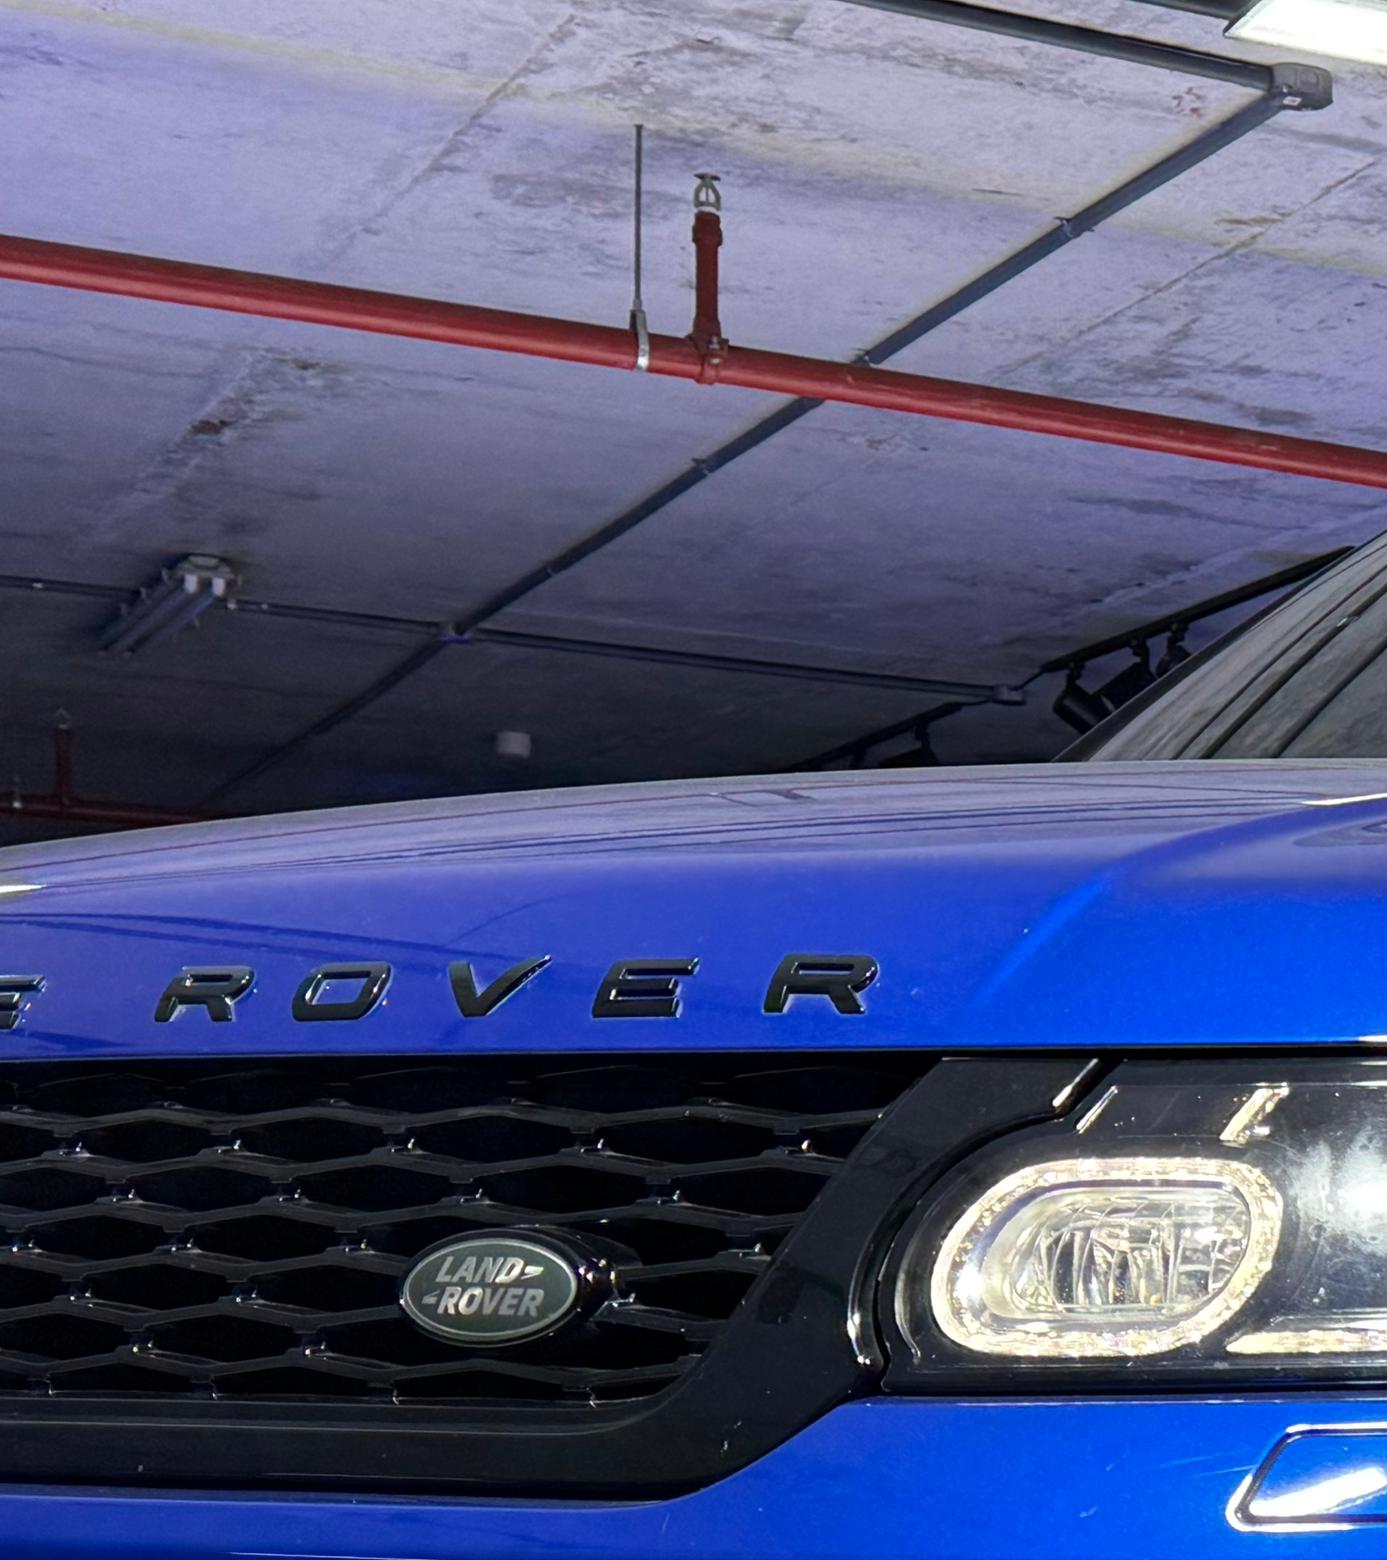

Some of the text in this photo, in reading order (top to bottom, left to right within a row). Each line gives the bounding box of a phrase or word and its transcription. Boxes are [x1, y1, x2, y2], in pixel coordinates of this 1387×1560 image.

[154, 953, 881, 1024] ROVER
[435, 1255, 525, 1284] LAND
[437, 1286, 545, 1317] ROVER
